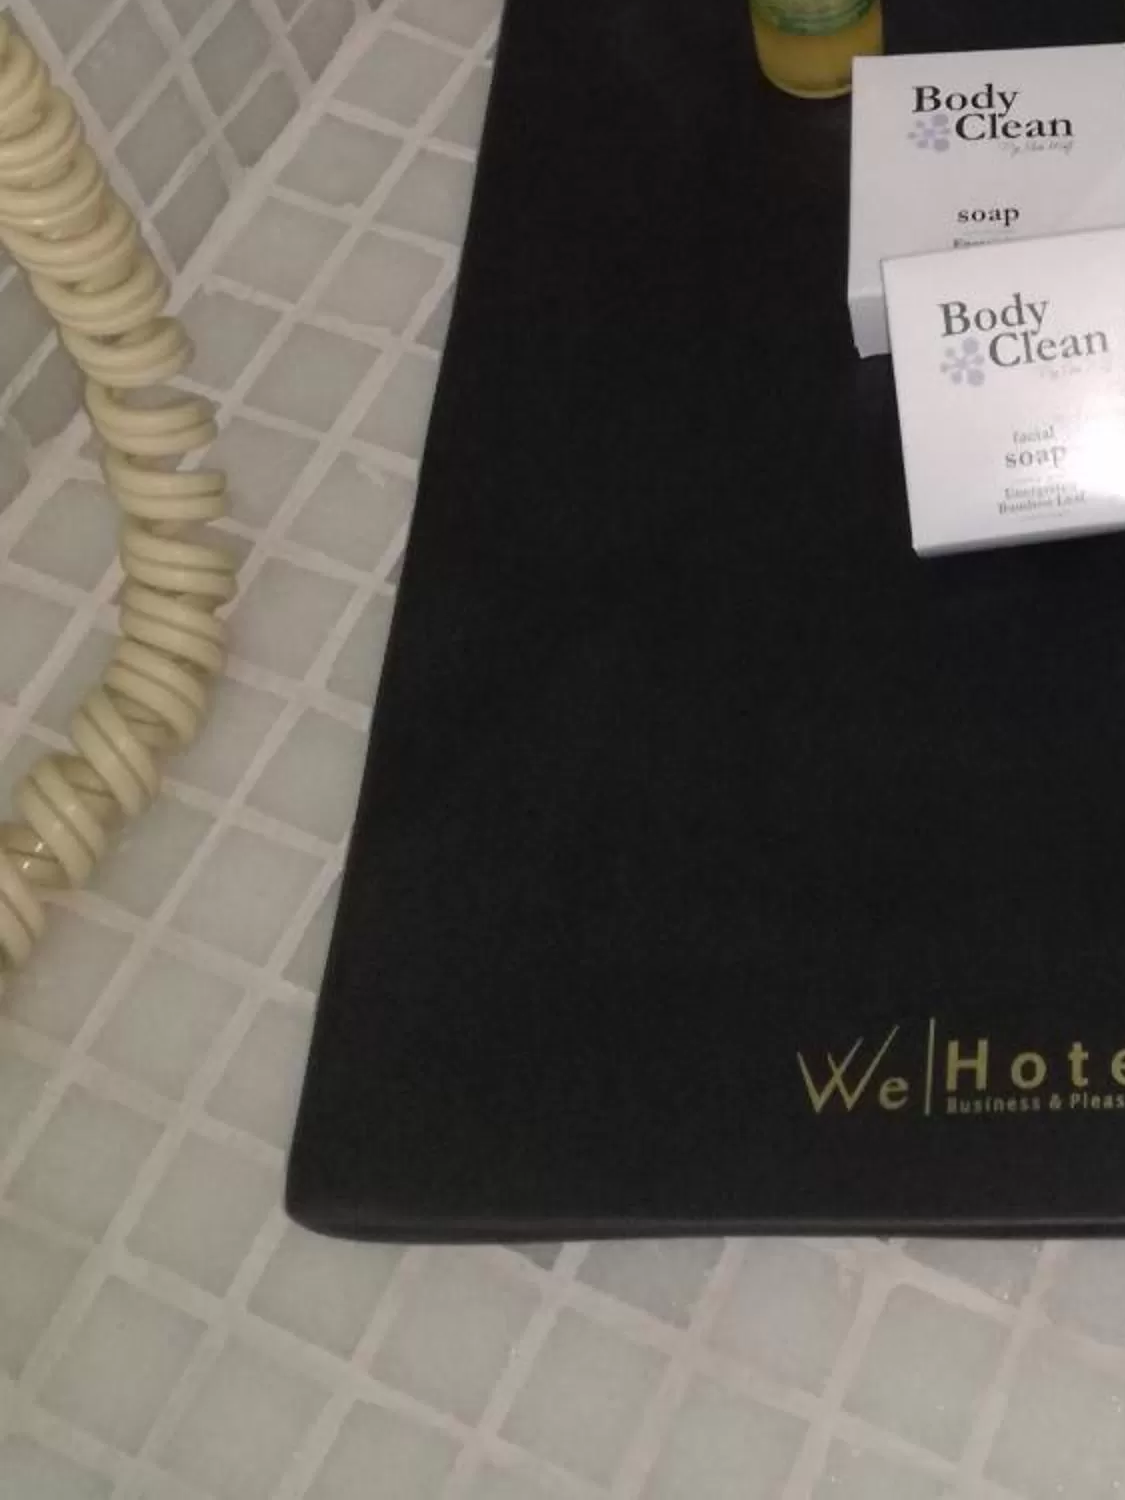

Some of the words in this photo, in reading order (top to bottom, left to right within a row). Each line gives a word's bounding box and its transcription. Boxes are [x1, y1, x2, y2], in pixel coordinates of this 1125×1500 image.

[912, 83, 1018, 117] Body
[955, 113, 1074, 141] Clean
[957, 206, 1020, 227] soap
[937, 292, 1049, 337] Body
[988, 331, 1110, 368] Clean
[1012, 425, 1055, 445] facial
[1004, 446, 1067, 469] soap
[797, 1025, 909, 1114] We
[946, 1096, 1041, 1114] Business
[1050, 1094, 1063, 1110] &
